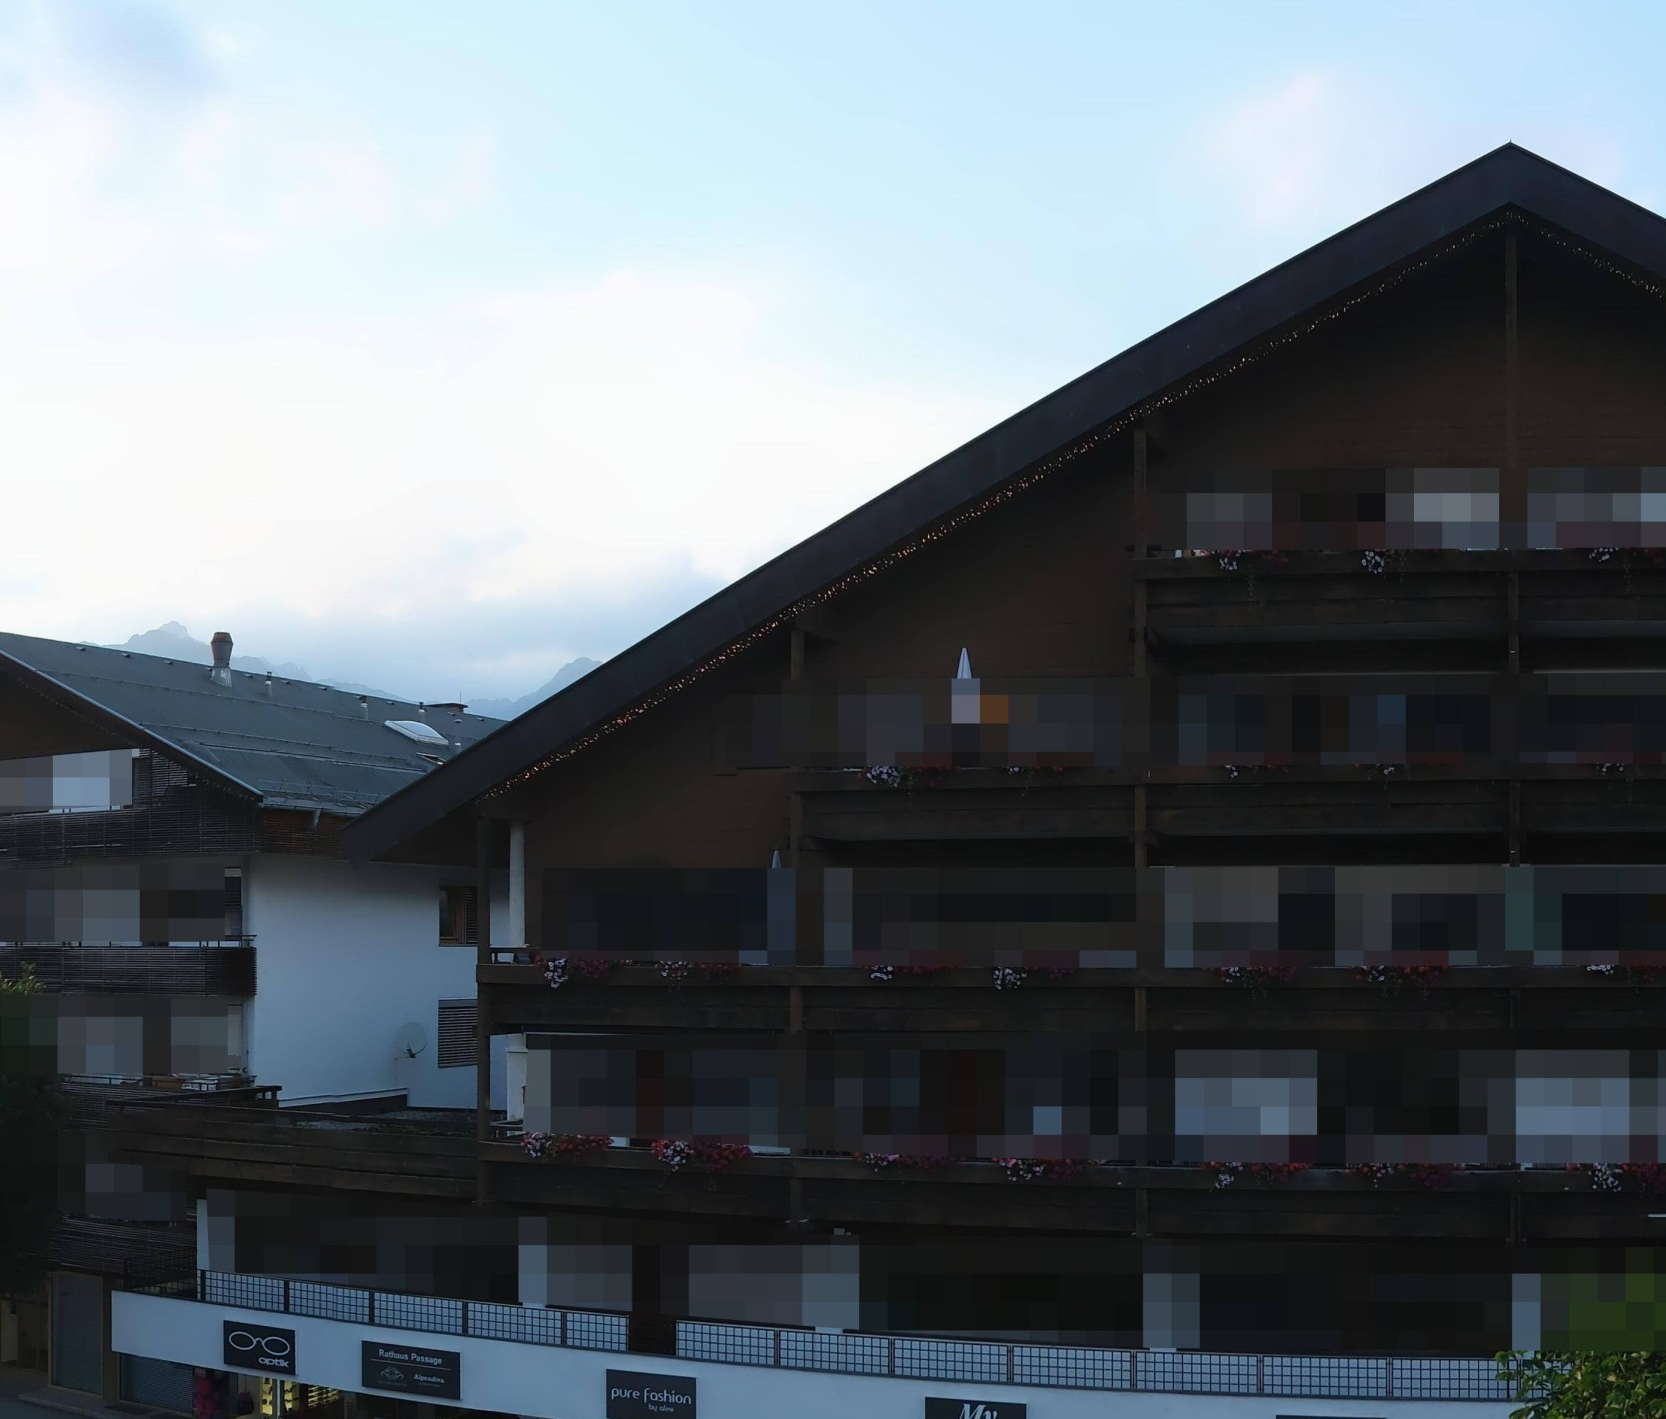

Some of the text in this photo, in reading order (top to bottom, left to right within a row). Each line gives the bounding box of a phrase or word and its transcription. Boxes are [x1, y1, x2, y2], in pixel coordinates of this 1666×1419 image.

[259, 1356, 289, 1368] optik
[379, 1349, 442, 1366] Rathaus Passage
[611, 1387, 692, 1404] pure fashion
